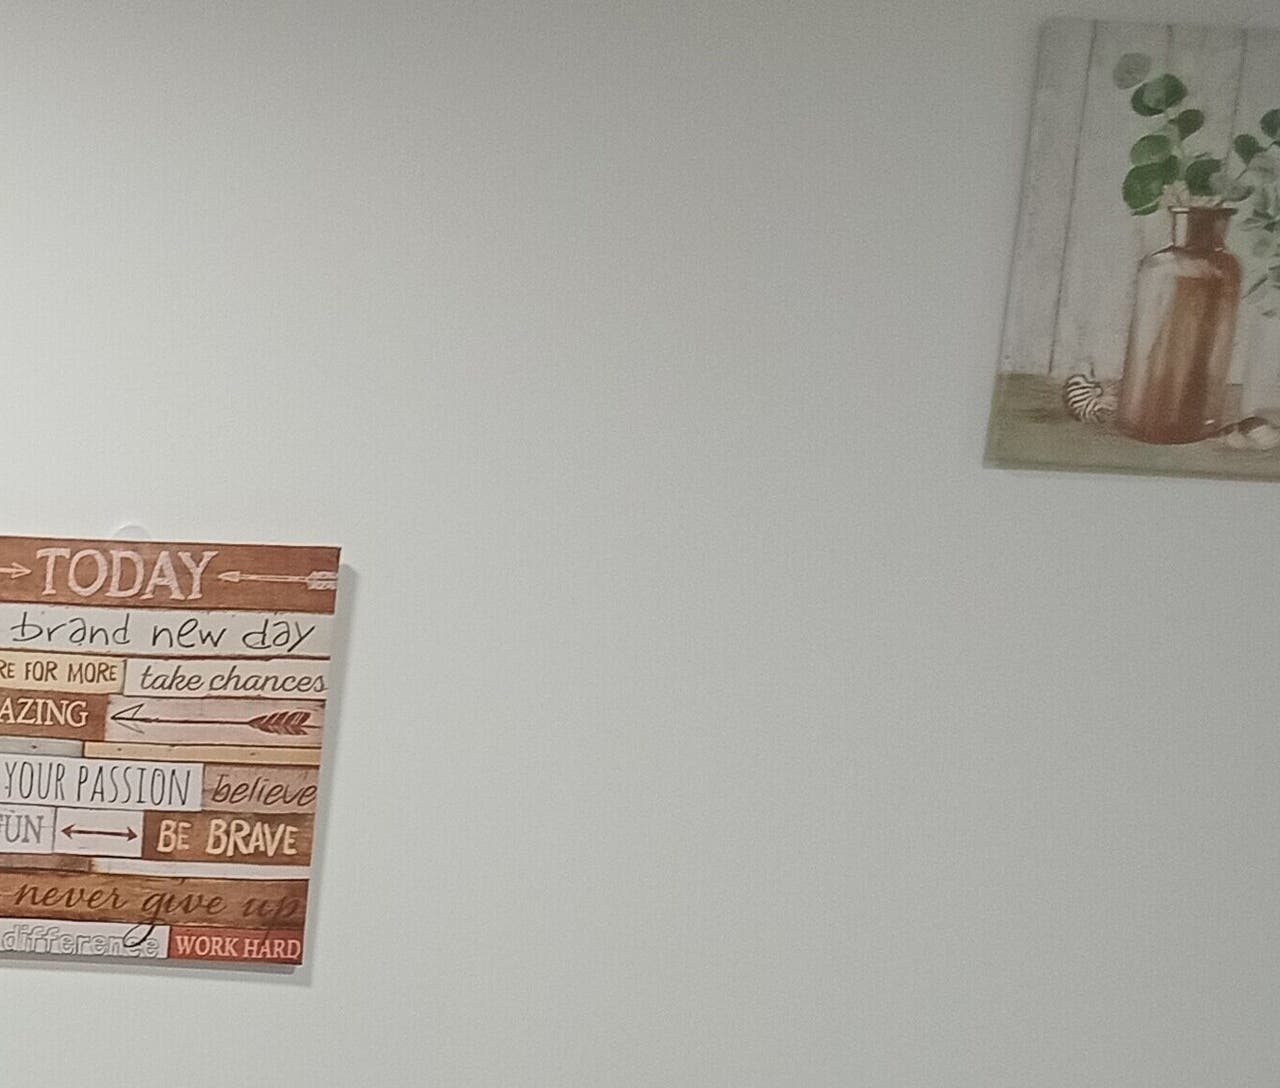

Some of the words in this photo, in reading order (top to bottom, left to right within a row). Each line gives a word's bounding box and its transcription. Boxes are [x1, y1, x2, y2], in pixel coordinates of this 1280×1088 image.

[36, 547, 219, 600] TODAY
[10, 610, 130, 646] brand
[152, 617, 227, 649] new
[242, 618, 316, 652] day
[25, 661, 57, 681] FOR
[67, 663, 118, 683] MORE
[140, 667, 205, 692] take
[208, 666, 326, 693] chances
[4, 760, 66, 801] YOUR
[76, 767, 191, 806] PASSION
[211, 772, 318, 807] believe
[157, 820, 189, 850] BE
[206, 819, 298, 856] BRAVE
[14, 883, 129, 908] never
[123, 890, 233, 948] give
[243, 896, 299, 939] up
[3, 922, 160, 958] difference
[176, 934, 241, 957] WORK
[243, 939, 301, 959] HARD
